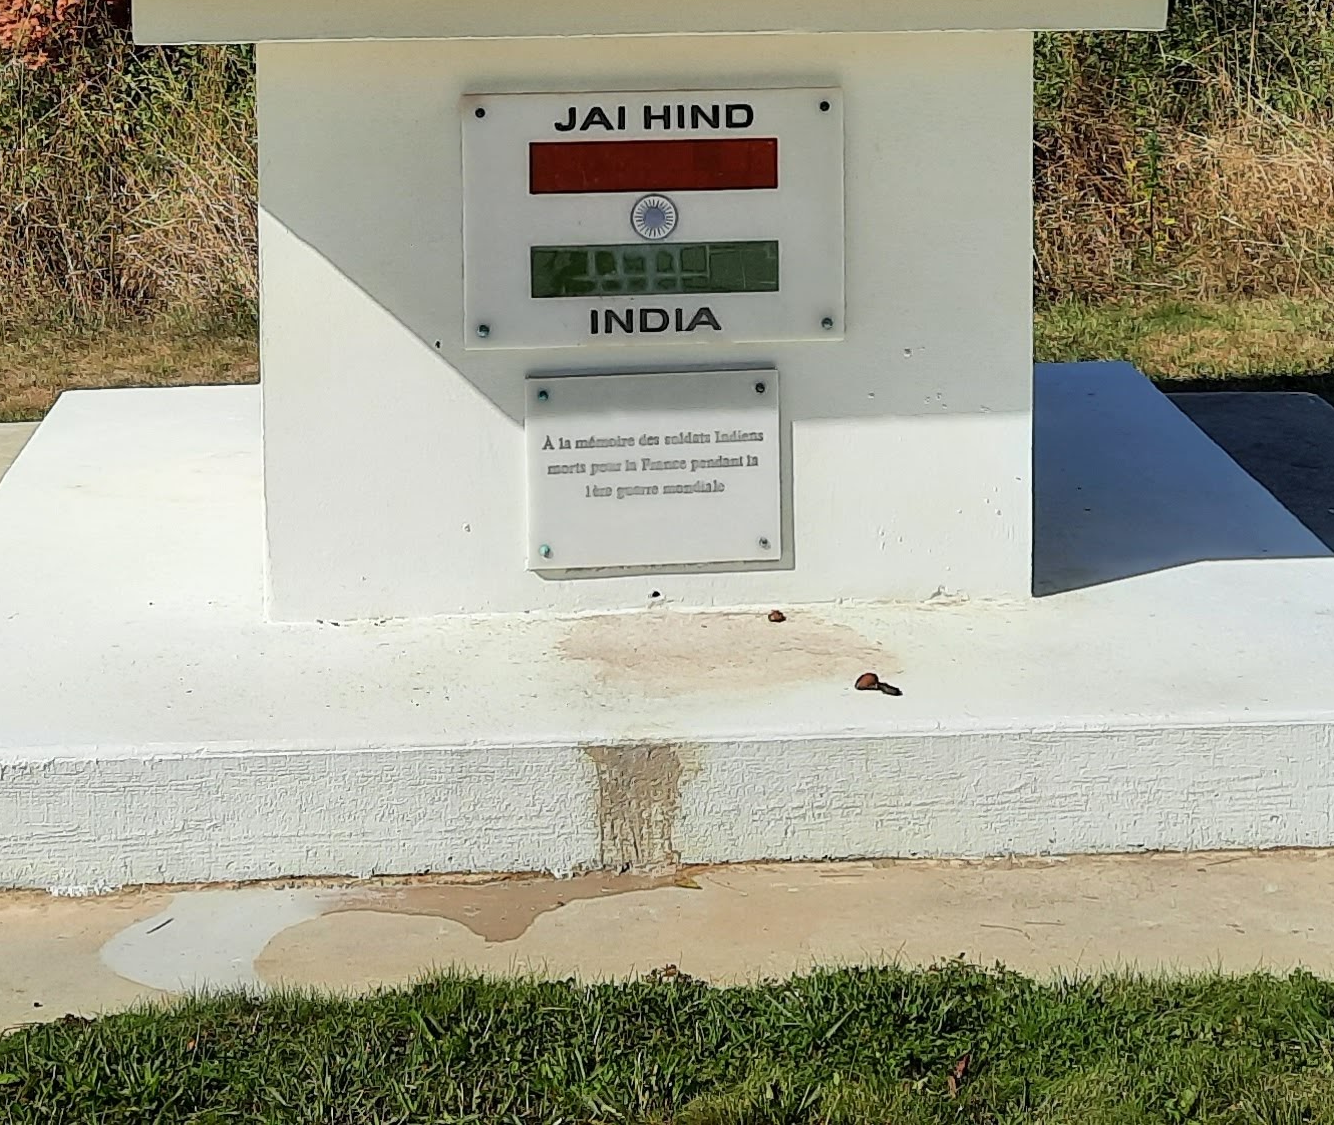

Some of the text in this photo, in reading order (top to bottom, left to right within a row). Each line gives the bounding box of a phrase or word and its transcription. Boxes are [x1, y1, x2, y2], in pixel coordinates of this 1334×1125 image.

[554, 104, 754, 131] JAI HIND
[590, 307, 721, 334] INDIA
[559, 435, 571, 449] la
[575, 435, 635, 449] mémoire
[639, 434, 659, 446] des
[665, 433, 710, 445] soldats
[715, 430, 763, 443] Indiens
[547, 455, 758, 476] morts pour la France pendant la
[617, 484, 658, 499] guerre
[663, 480, 725, 494] mondiale
